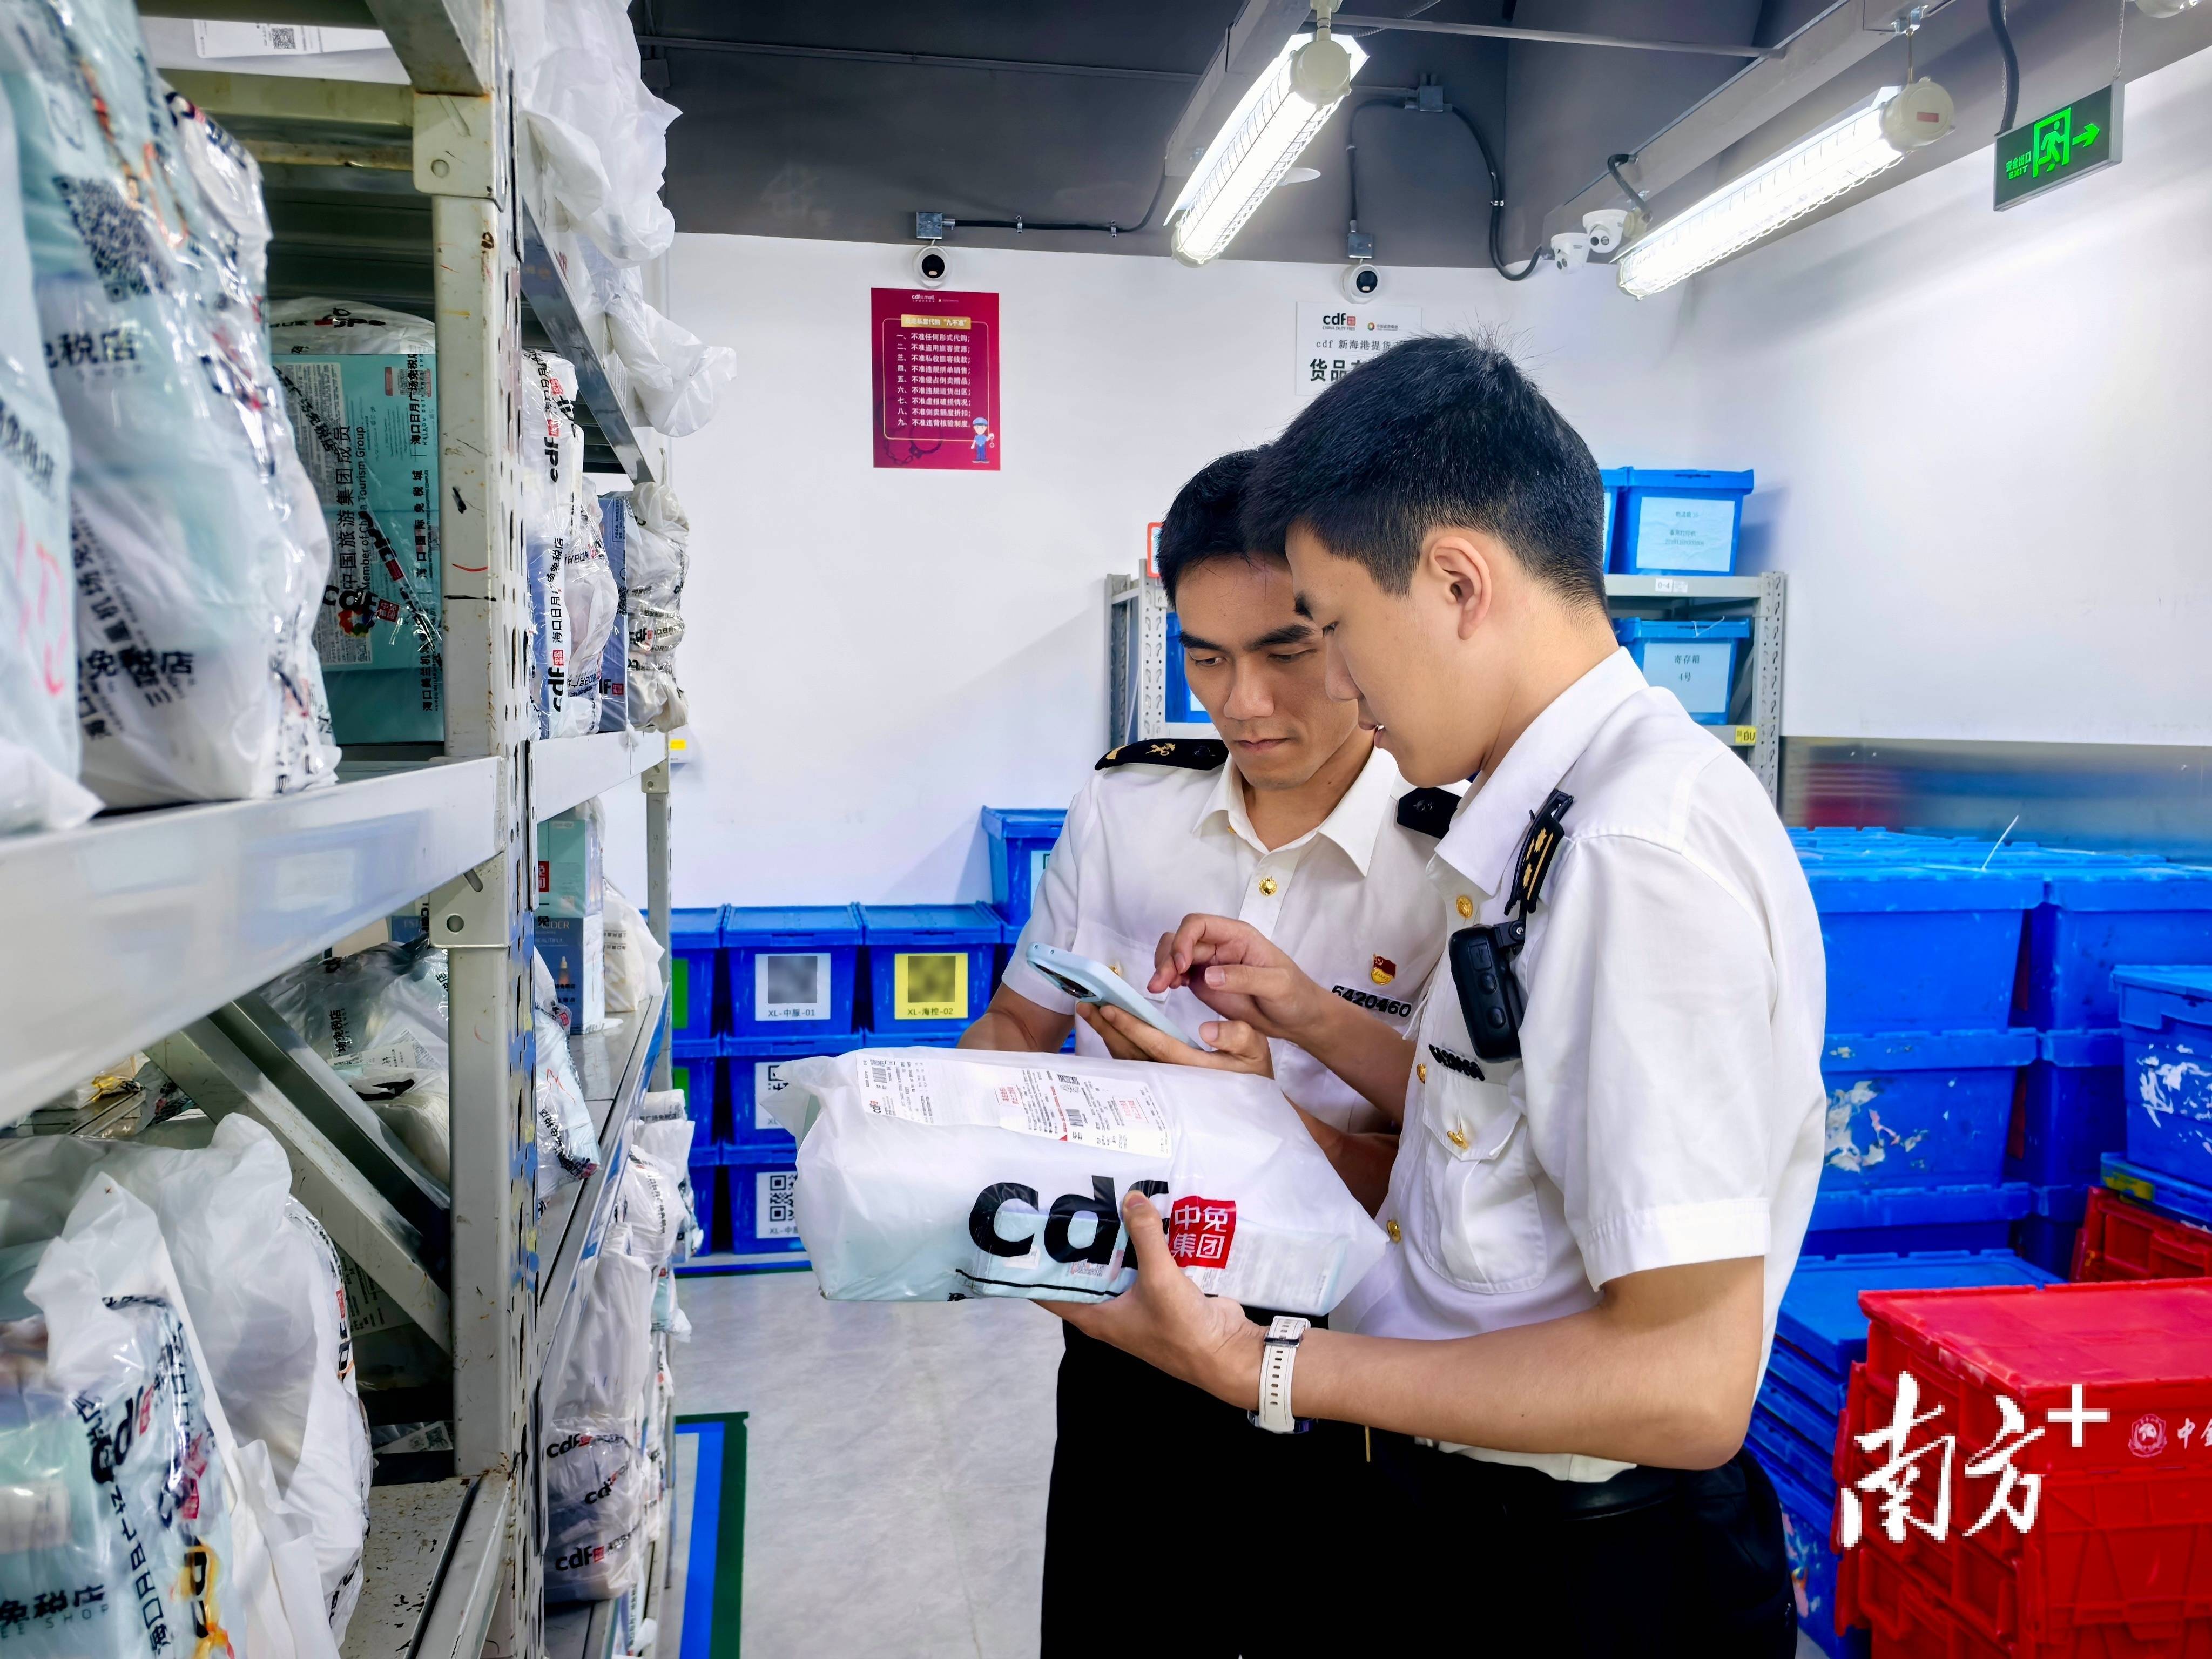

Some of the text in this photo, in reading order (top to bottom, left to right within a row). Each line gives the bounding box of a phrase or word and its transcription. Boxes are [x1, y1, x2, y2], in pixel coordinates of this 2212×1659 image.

[2008, 164, 2028, 180] EXIT
[1323, 312, 1347, 325] cdf
[1338, 339, 1400, 351] 新海港提货
[1309, 358, 1363, 382] 货品
[355, 426, 366, 458] Group
[356, 461, 367, 501] Tourism
[334, 426, 358, 590] 中国旅游集团成员
[359, 535, 370, 547] of
[360, 550, 372, 591] Member
[548, 667, 564, 712] cdf
[908, 1008, 954, 1016] XL-海控-02
[329, 1010, 346, 1057] 场免税店
[1174, 1205, 1228, 1233] 中免
[1170, 1233, 1225, 1259] 集团
[546, 1433, 582, 1458] cdf
[555, 1545, 594, 1572] cdf
[45, 1603, 109, 1629] SHOP
